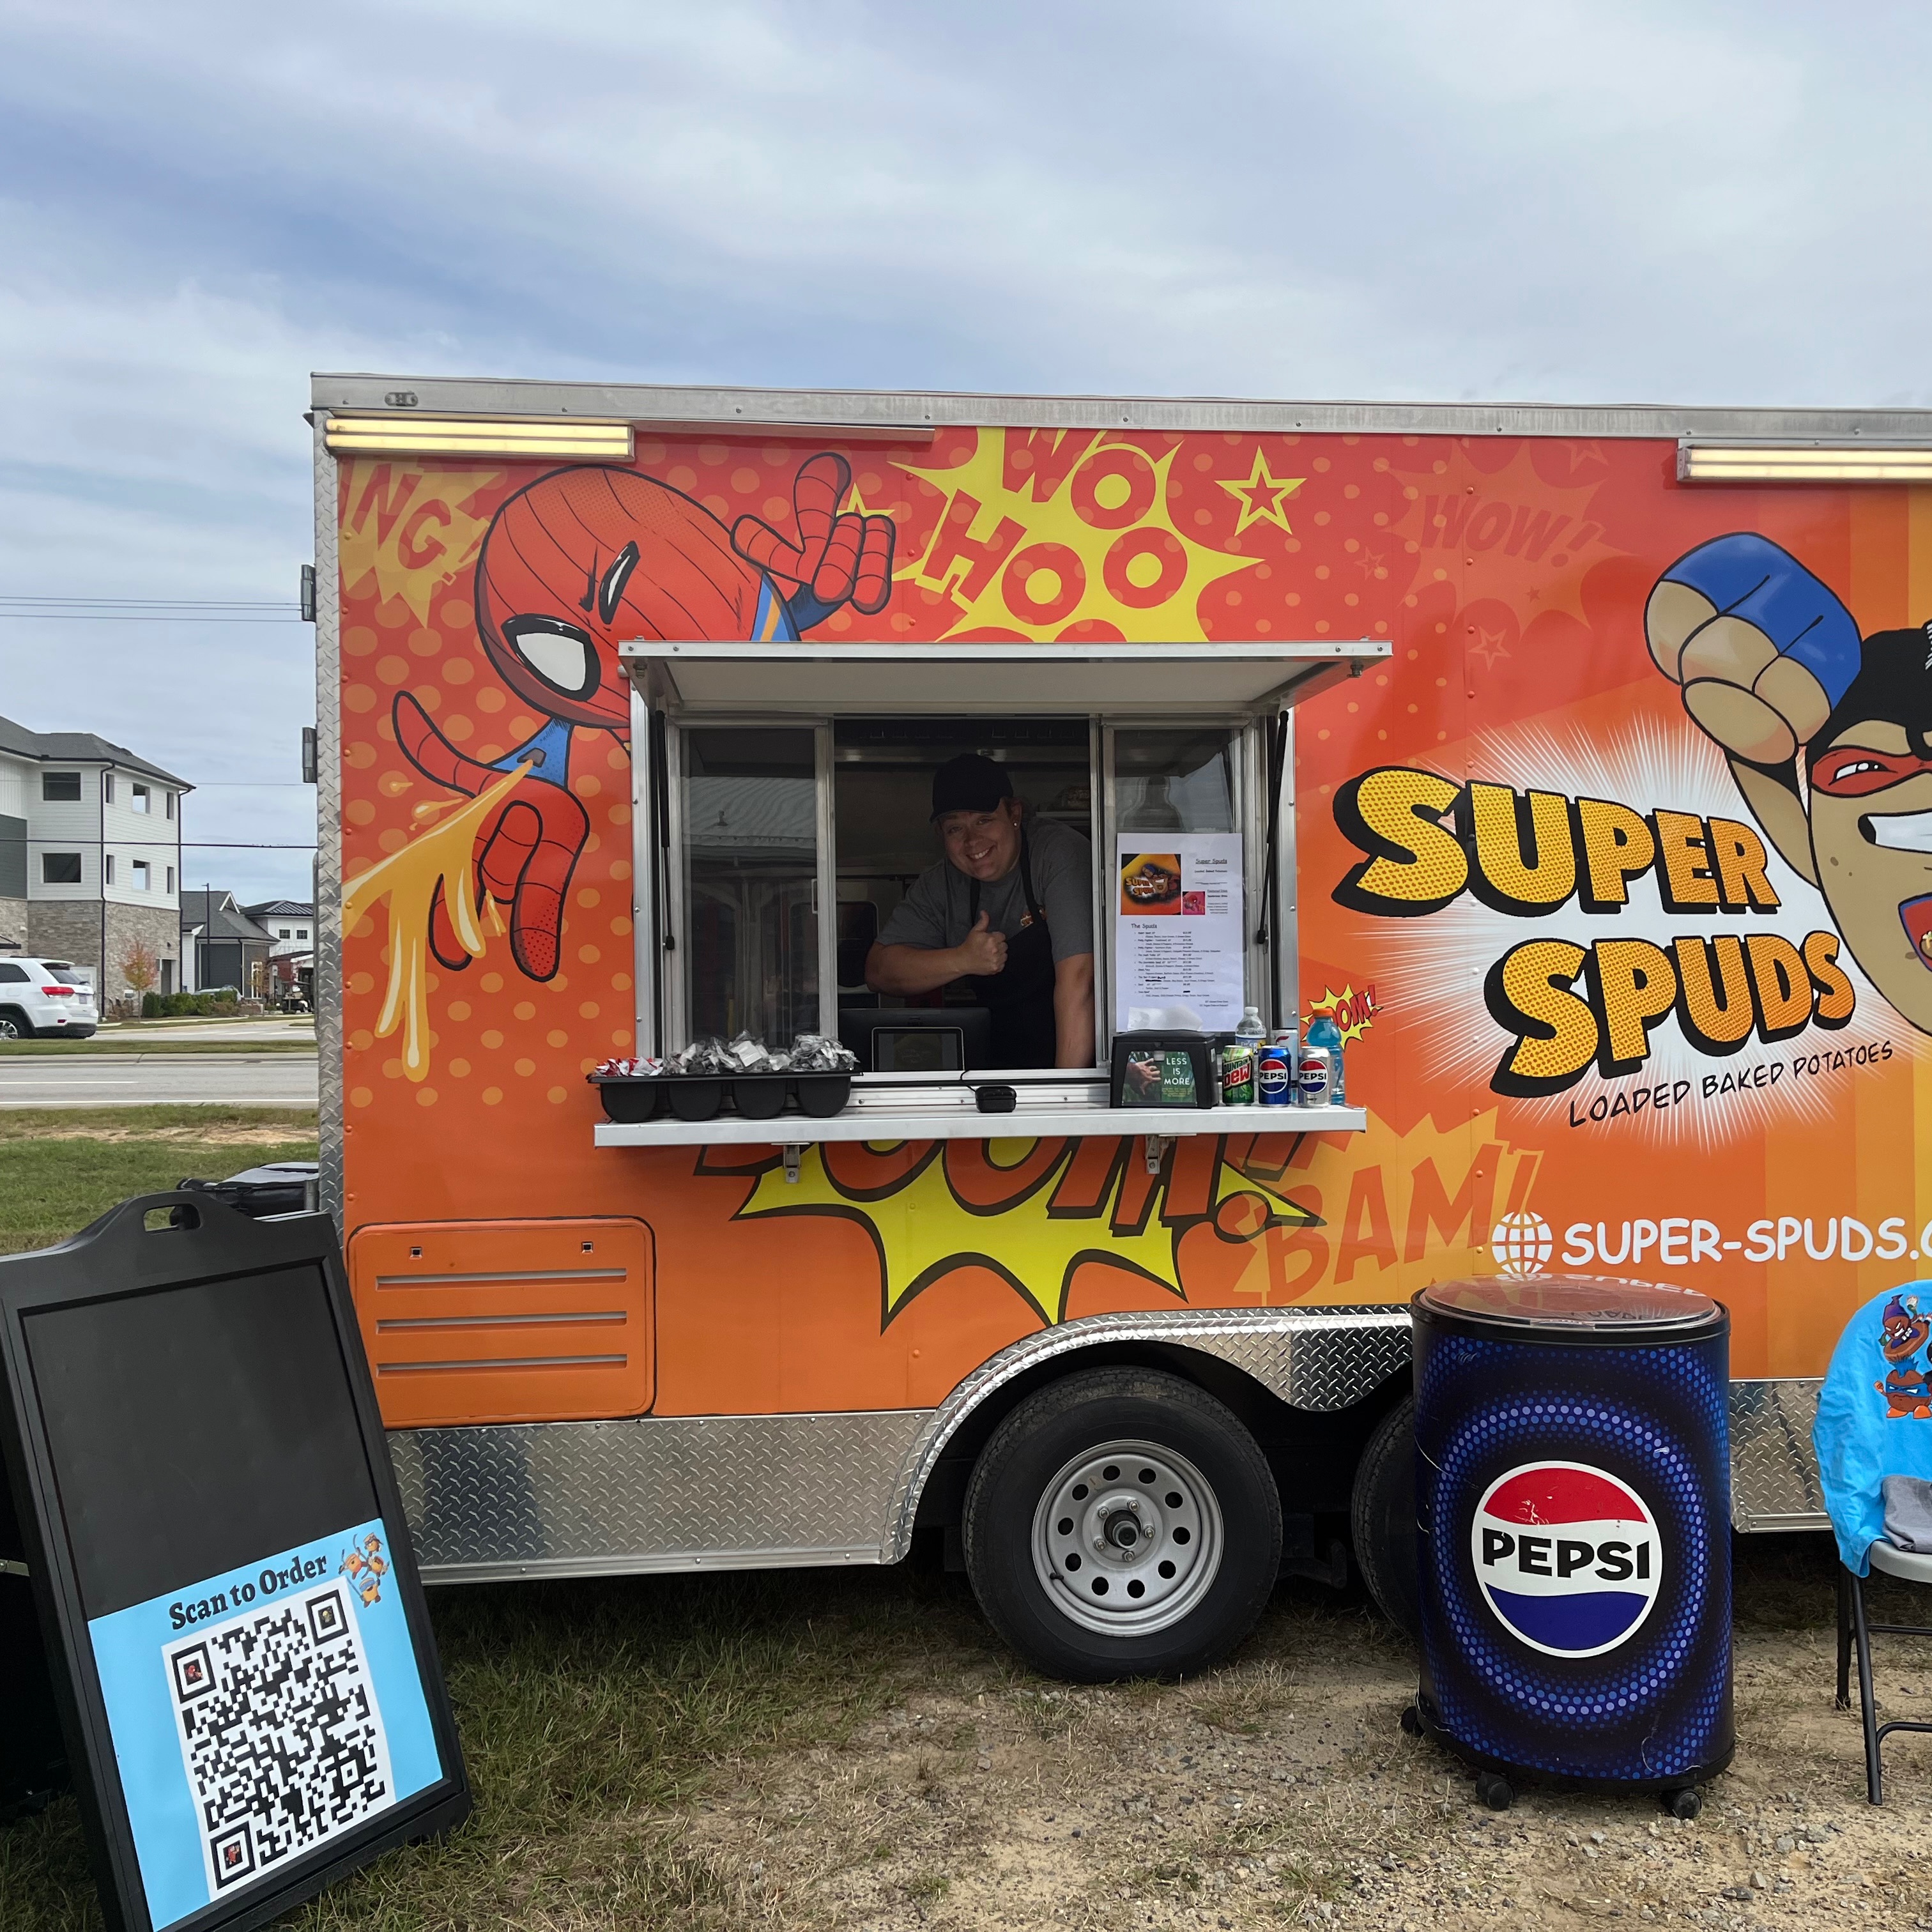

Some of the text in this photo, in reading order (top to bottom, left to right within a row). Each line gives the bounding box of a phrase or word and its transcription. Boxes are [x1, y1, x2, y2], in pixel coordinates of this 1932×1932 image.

[921, 488, 1188, 626] HOO
[1420, 494, 1602, 568] WOW!
[1331, 765, 1782, 918] SUPER
[1483, 930, 1857, 1098] SPUDS
[1569, 1040, 1894, 1128] LOADED BAKED POTATOES
[169, 1555, 326, 1630] Scan to Order
[1482, 1527, 1650, 1581] PEPSI
